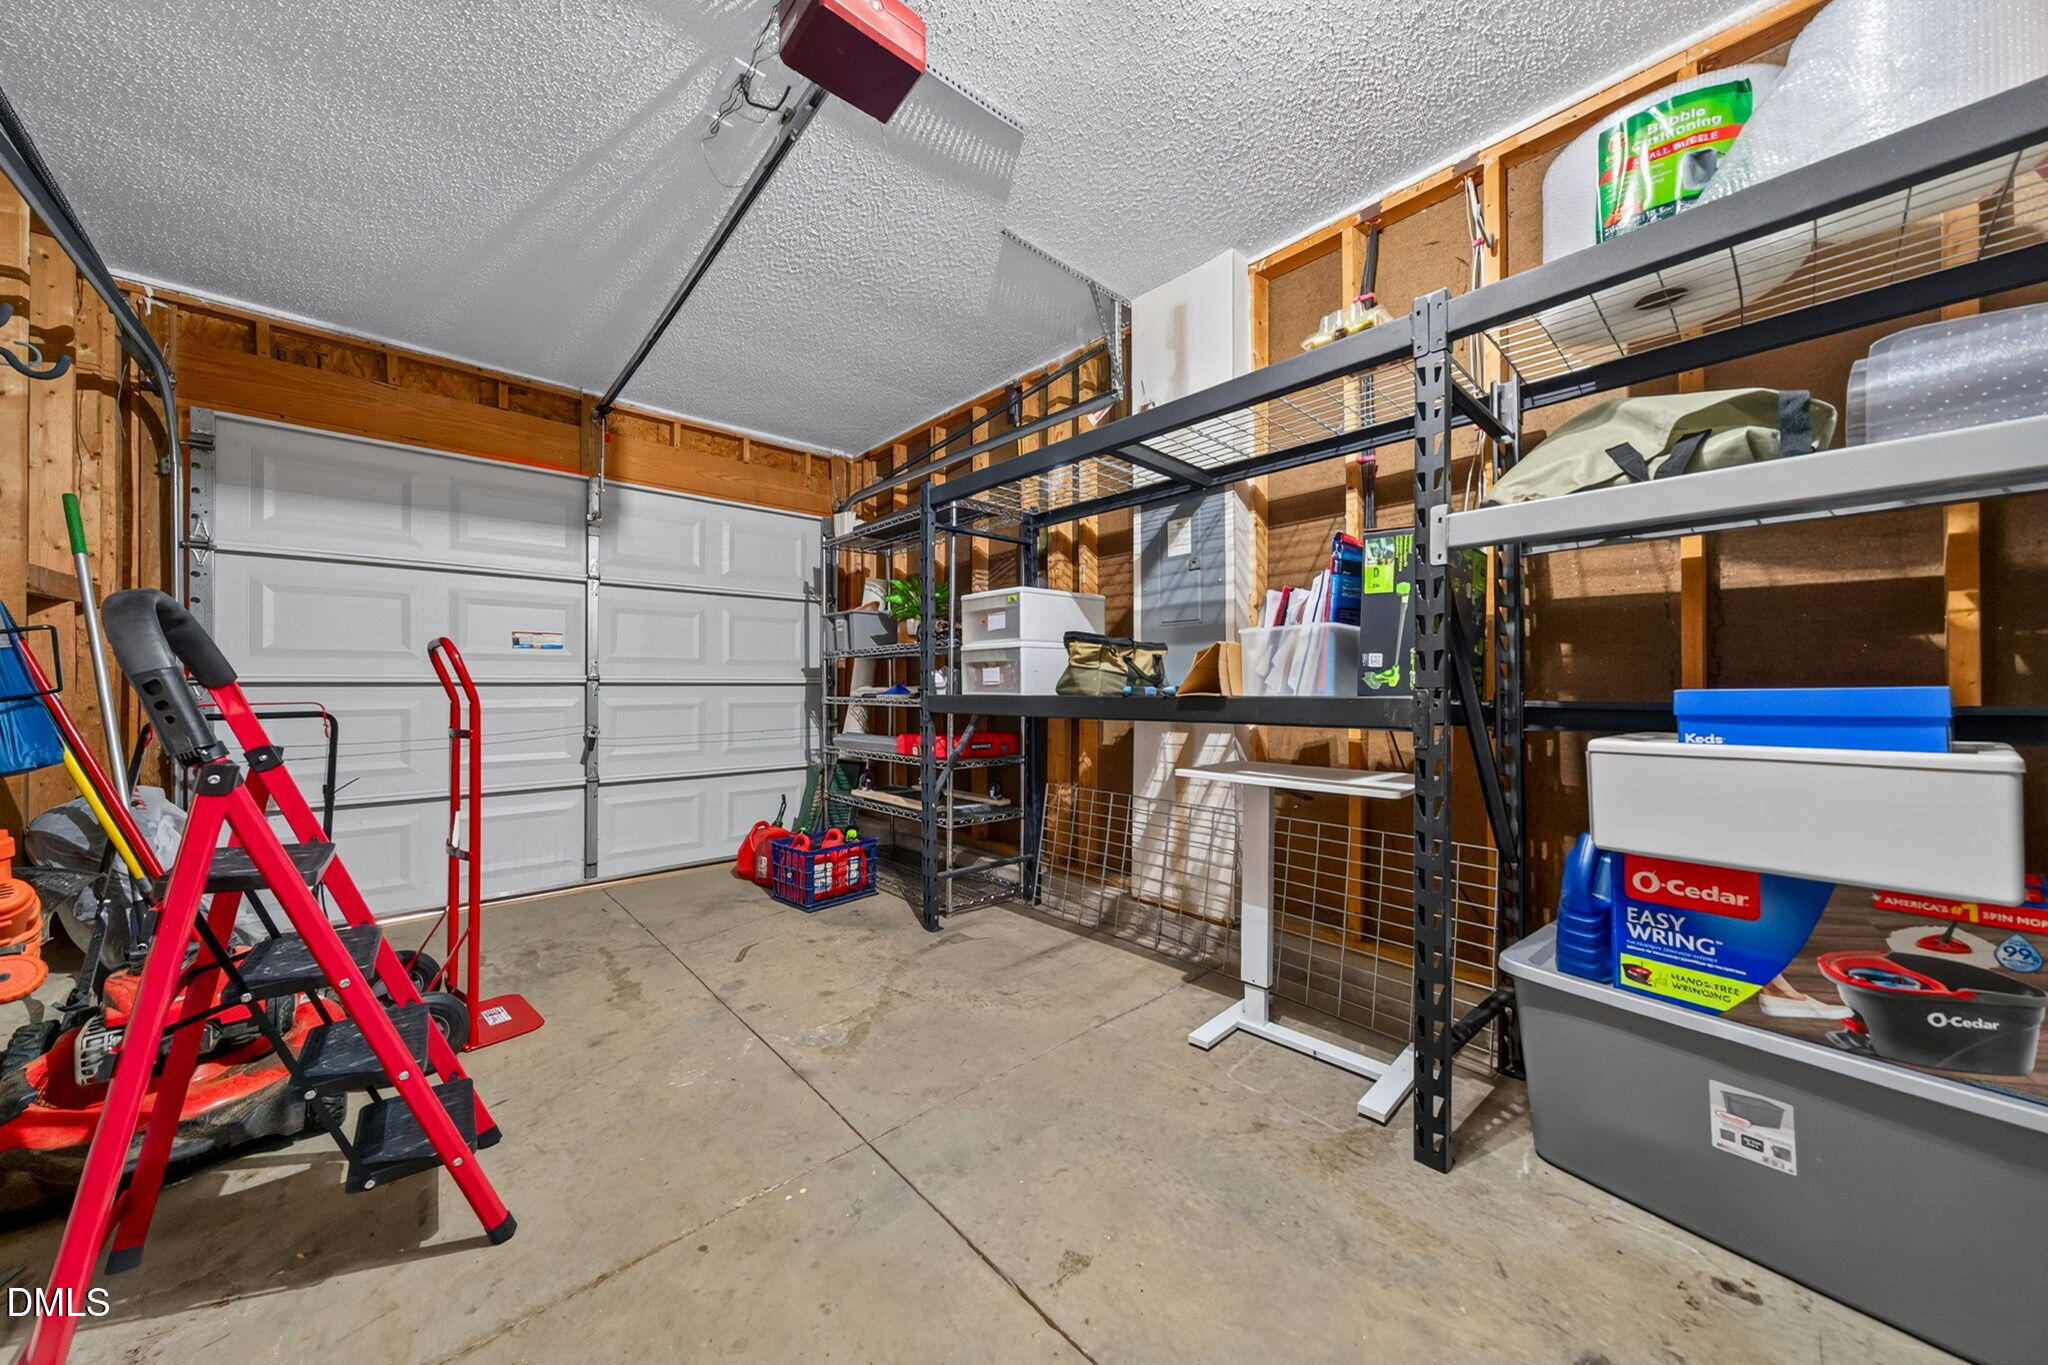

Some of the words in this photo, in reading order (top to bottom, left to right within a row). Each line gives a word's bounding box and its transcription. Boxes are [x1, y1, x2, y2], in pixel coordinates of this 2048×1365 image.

[1685, 733, 1724, 744] Keds
[1632, 870, 1750, 906] O-Cedar
[1627, 907, 1686, 932] EASY
[1885, 897, 1949, 914] AMERICA'S
[1982, 911, 2013, 923] SPIN
[1927, 1012, 2000, 1030] O-Cedar
